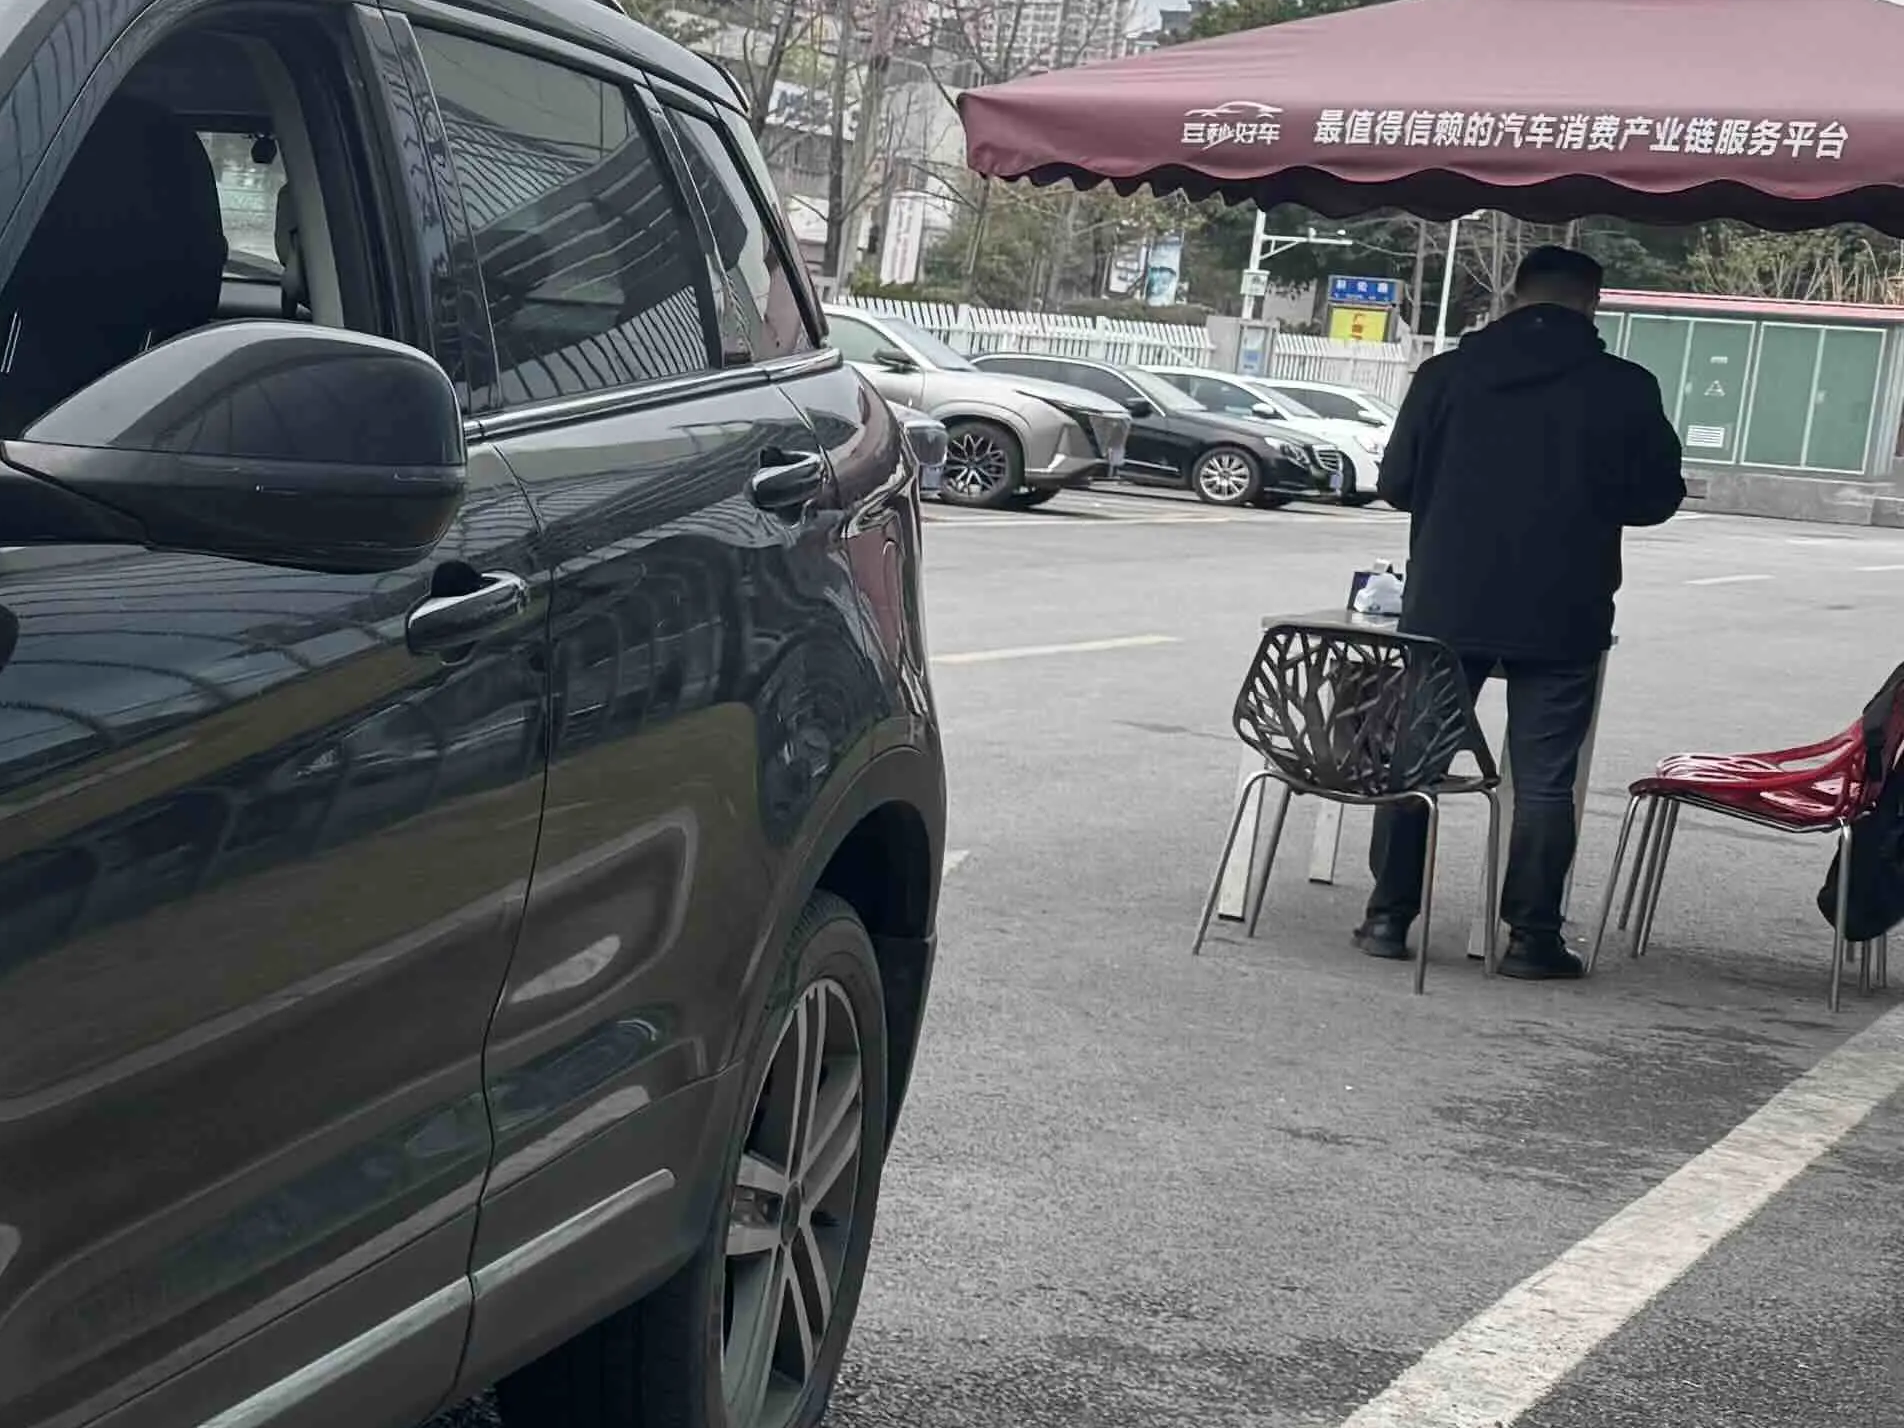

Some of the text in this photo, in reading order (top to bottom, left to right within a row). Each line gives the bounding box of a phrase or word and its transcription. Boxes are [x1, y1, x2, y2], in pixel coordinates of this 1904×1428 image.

[1313, 109, 1849, 160] 最值得信赖的汽车消费产业链服务平台
